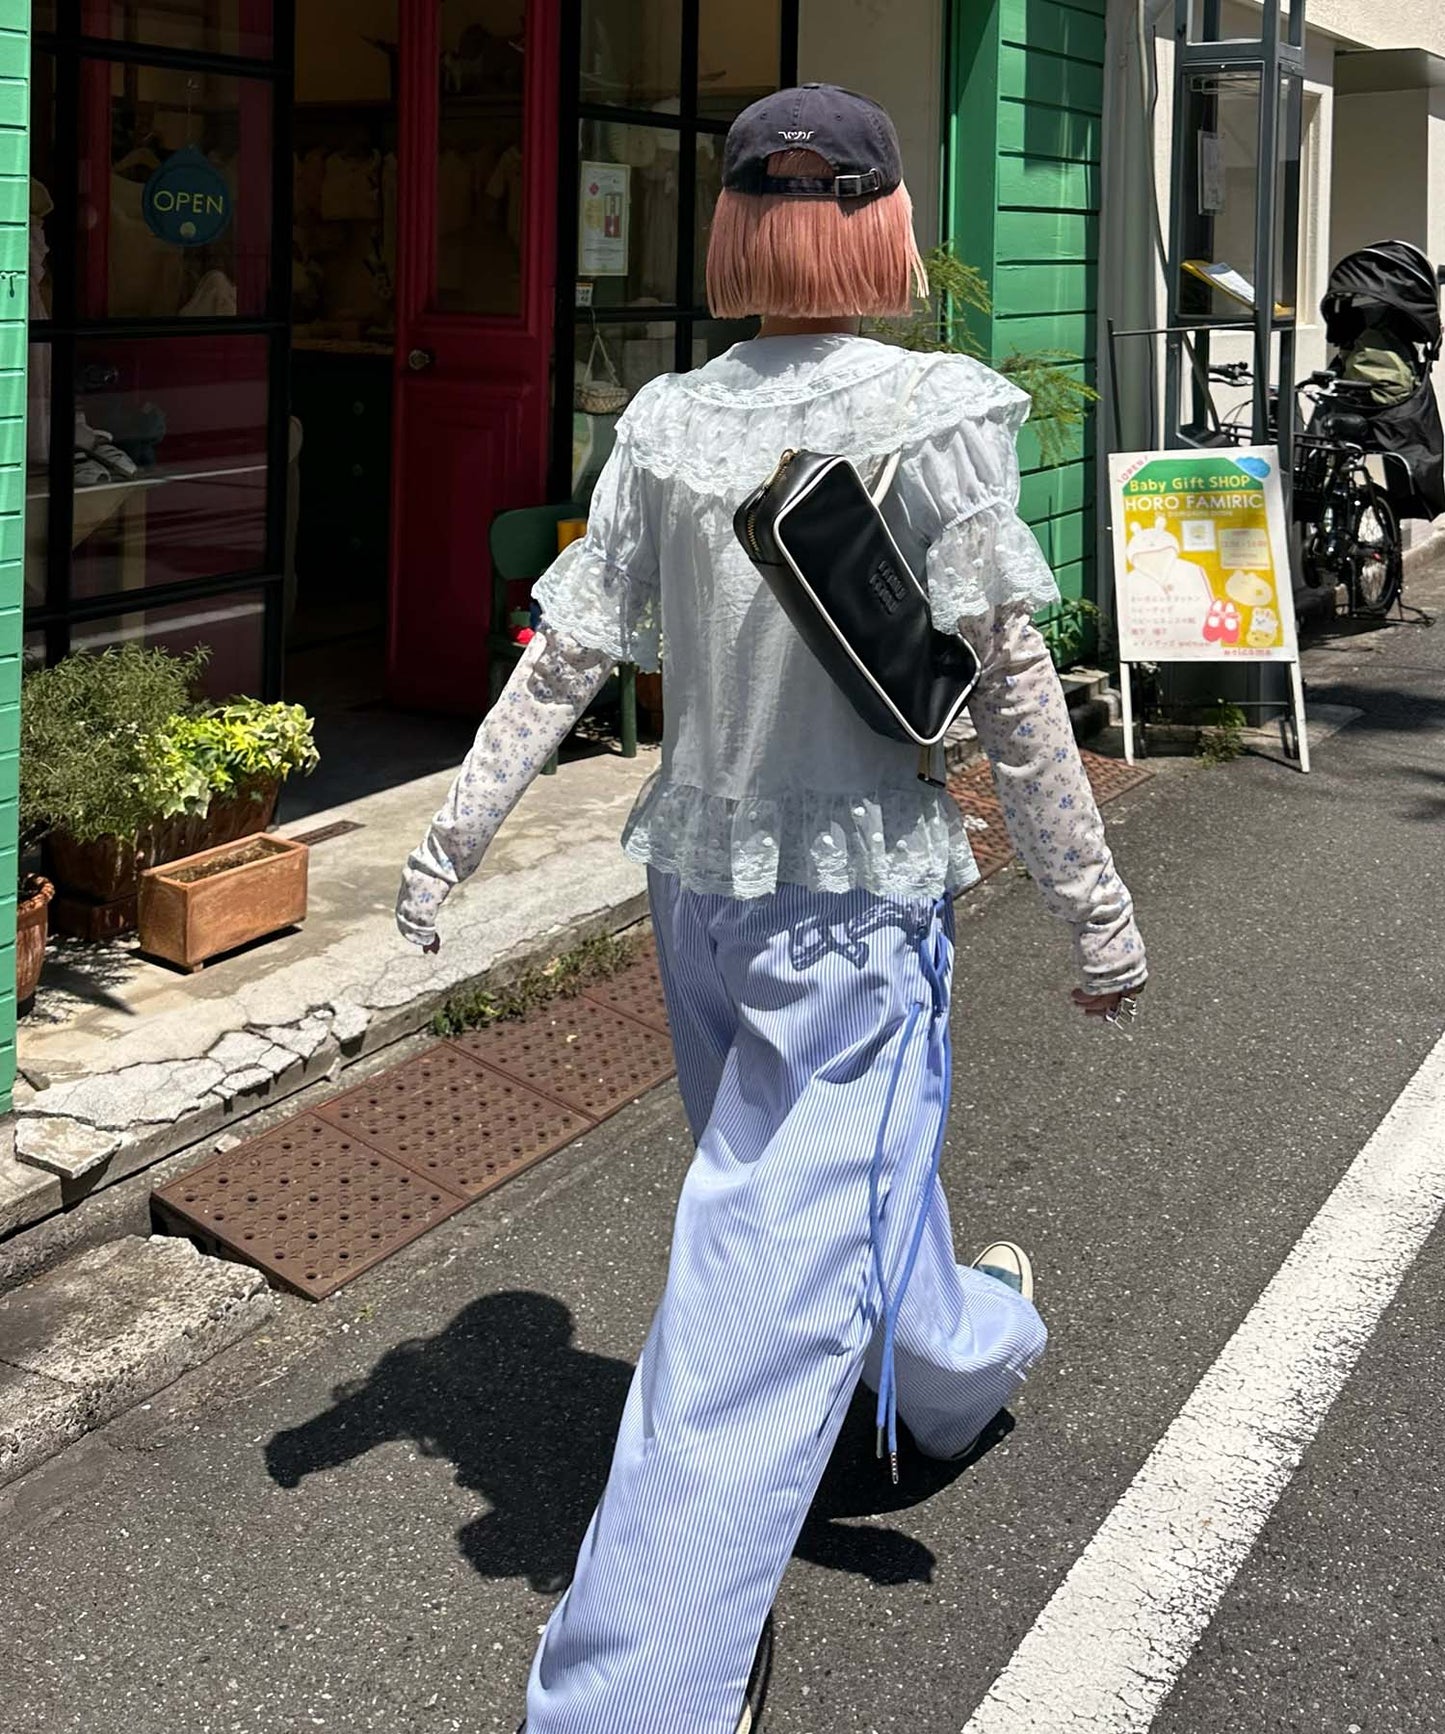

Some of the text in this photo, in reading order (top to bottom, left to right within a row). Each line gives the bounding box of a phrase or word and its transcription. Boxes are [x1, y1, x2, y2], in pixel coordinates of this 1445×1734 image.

[153, 190, 223, 214] OPEN
[1129, 475, 1250, 492] Baby Gift SHOP
[1125, 494, 1264, 511] HORO FAMIRIC
